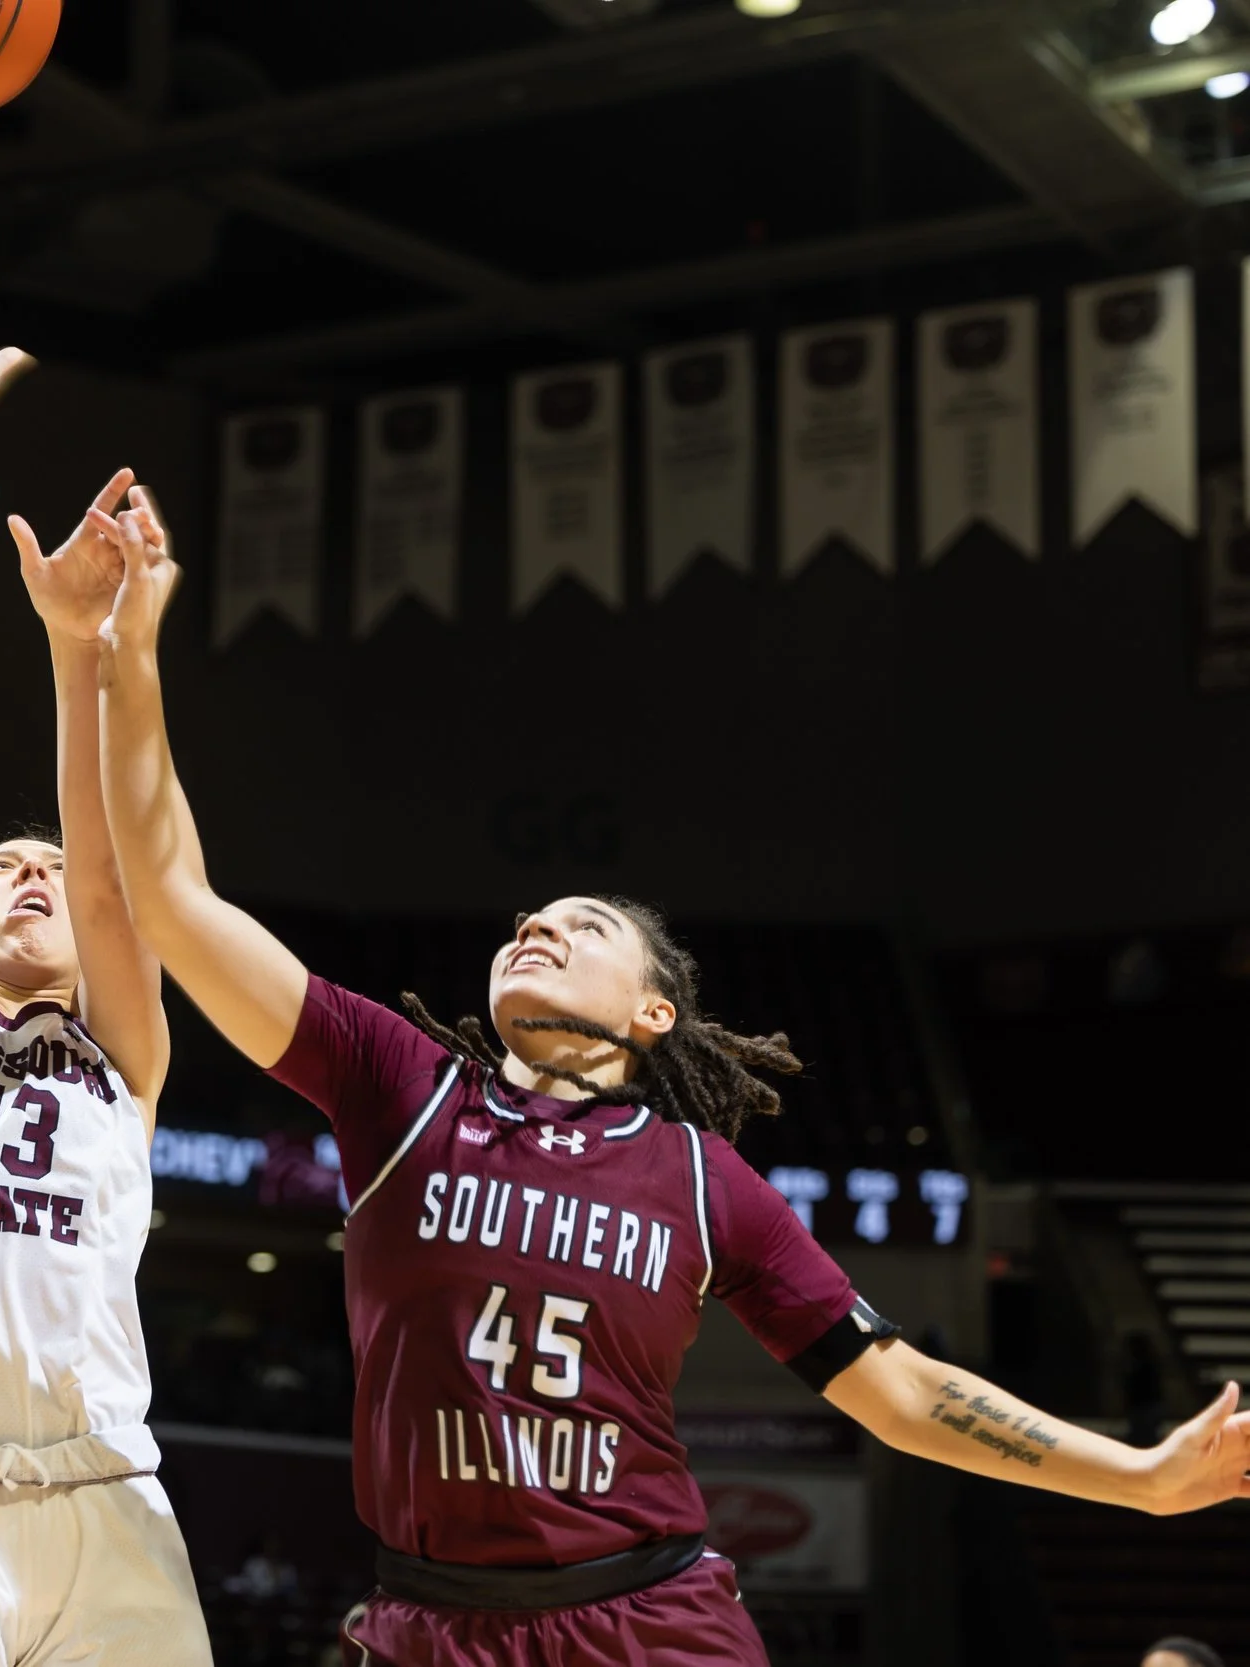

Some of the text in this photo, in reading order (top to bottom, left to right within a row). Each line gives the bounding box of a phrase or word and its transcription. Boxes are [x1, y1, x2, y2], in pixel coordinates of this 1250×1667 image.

[417, 1171, 672, 1293] SOUTHERN
[466, 1283, 592, 1400] 45
[435, 1408, 621, 1494] ILLINOIS
